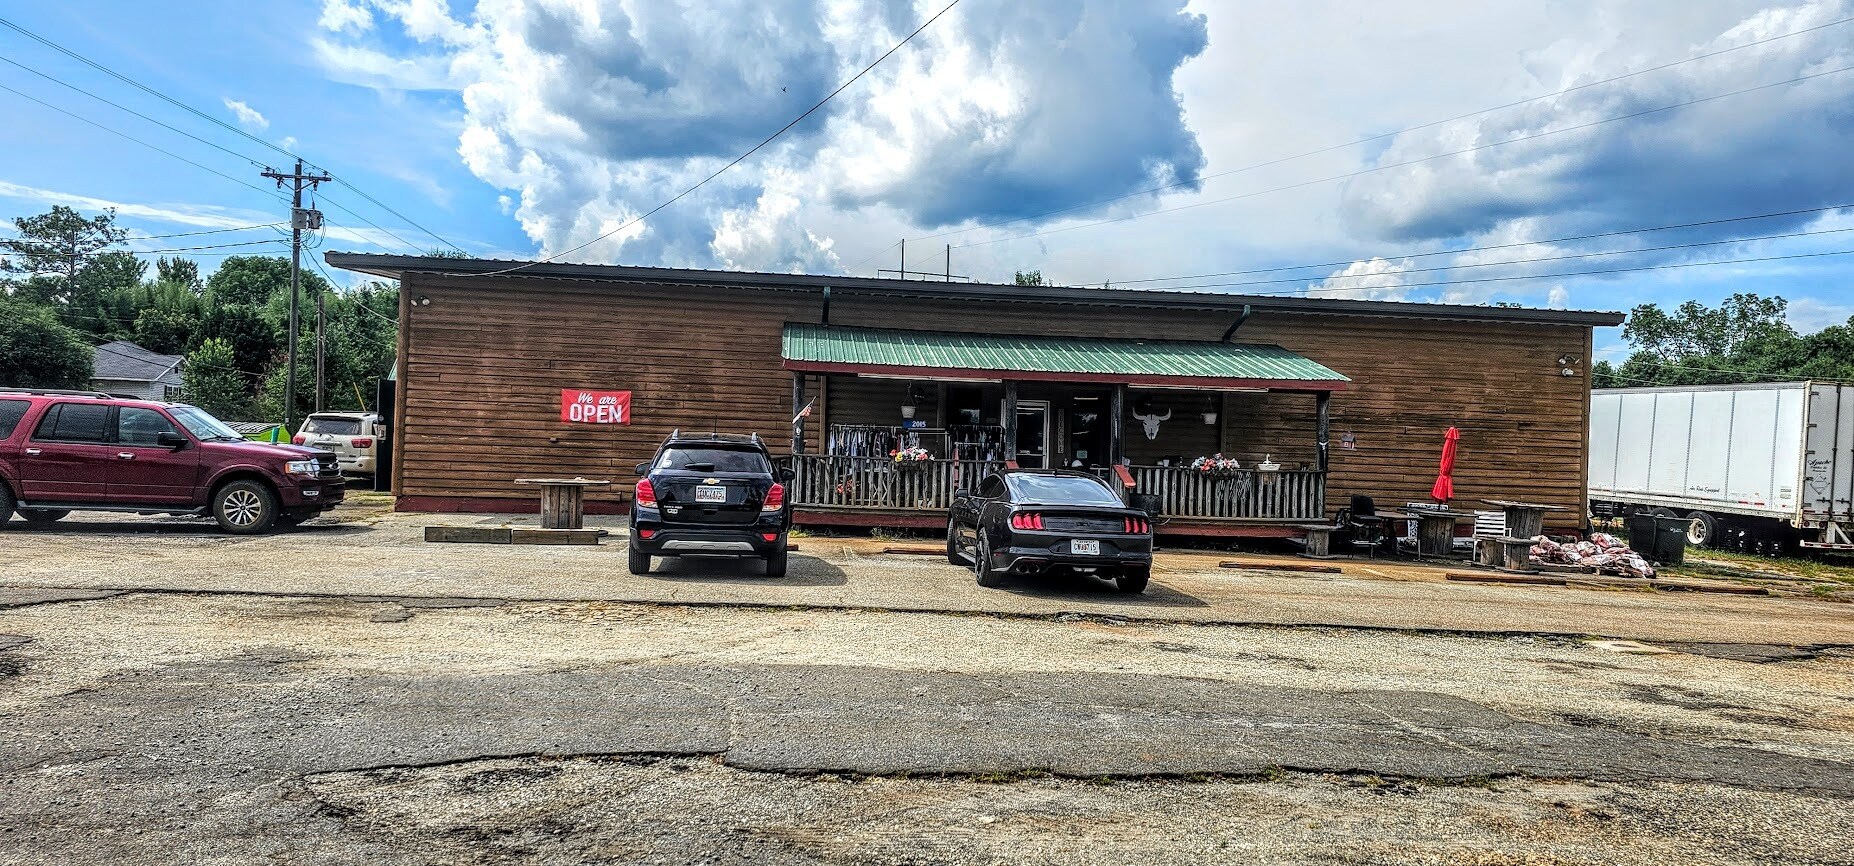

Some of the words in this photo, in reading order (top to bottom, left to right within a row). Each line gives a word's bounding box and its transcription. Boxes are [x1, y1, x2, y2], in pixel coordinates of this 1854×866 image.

[577, 392, 593, 404] We
[599, 395, 618, 404] are
[569, 403, 622, 423] OPEN
